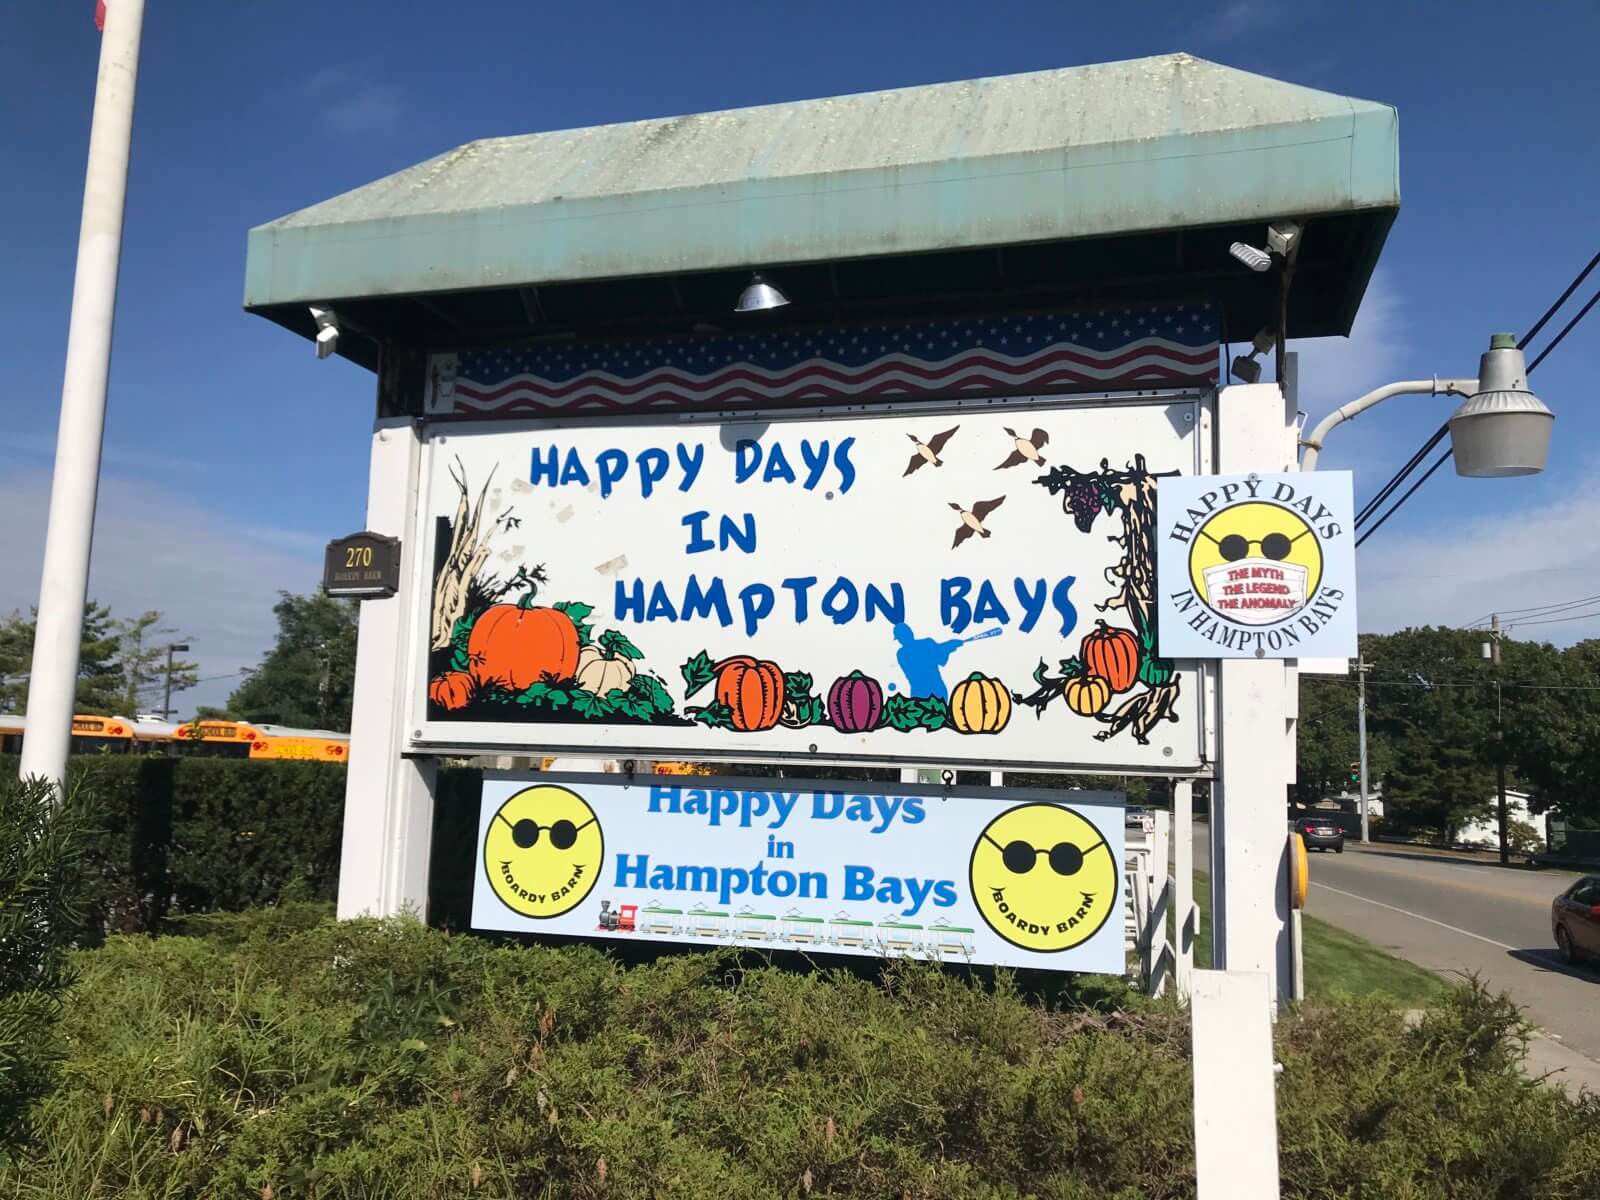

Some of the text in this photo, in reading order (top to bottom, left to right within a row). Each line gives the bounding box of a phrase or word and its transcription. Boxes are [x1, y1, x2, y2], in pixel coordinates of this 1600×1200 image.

[531, 437, 856, 499] HAPPY DAYS
[682, 512, 757, 554] IN
[1169, 480, 1342, 544] HAPPY DAYS
[345, 547, 372, 568] 270
[1228, 567, 1284, 580] THE MYTH
[614, 576, 1078, 638] HAMPTON BAYS
[1217, 598, 1297, 609] THE ANOMALY
[1222, 583, 1290, 595] THE LEGEND
[1170, 586, 1344, 651] IN HAMPTON BAYS
[647, 784, 926, 834] Happy Days
[767, 834, 795, 859] in
[501, 863, 584, 903] BOARDY BARN
[613, 853, 958, 917] Hampton Bays
[992, 891, 1094, 935] BOARDY BARN
